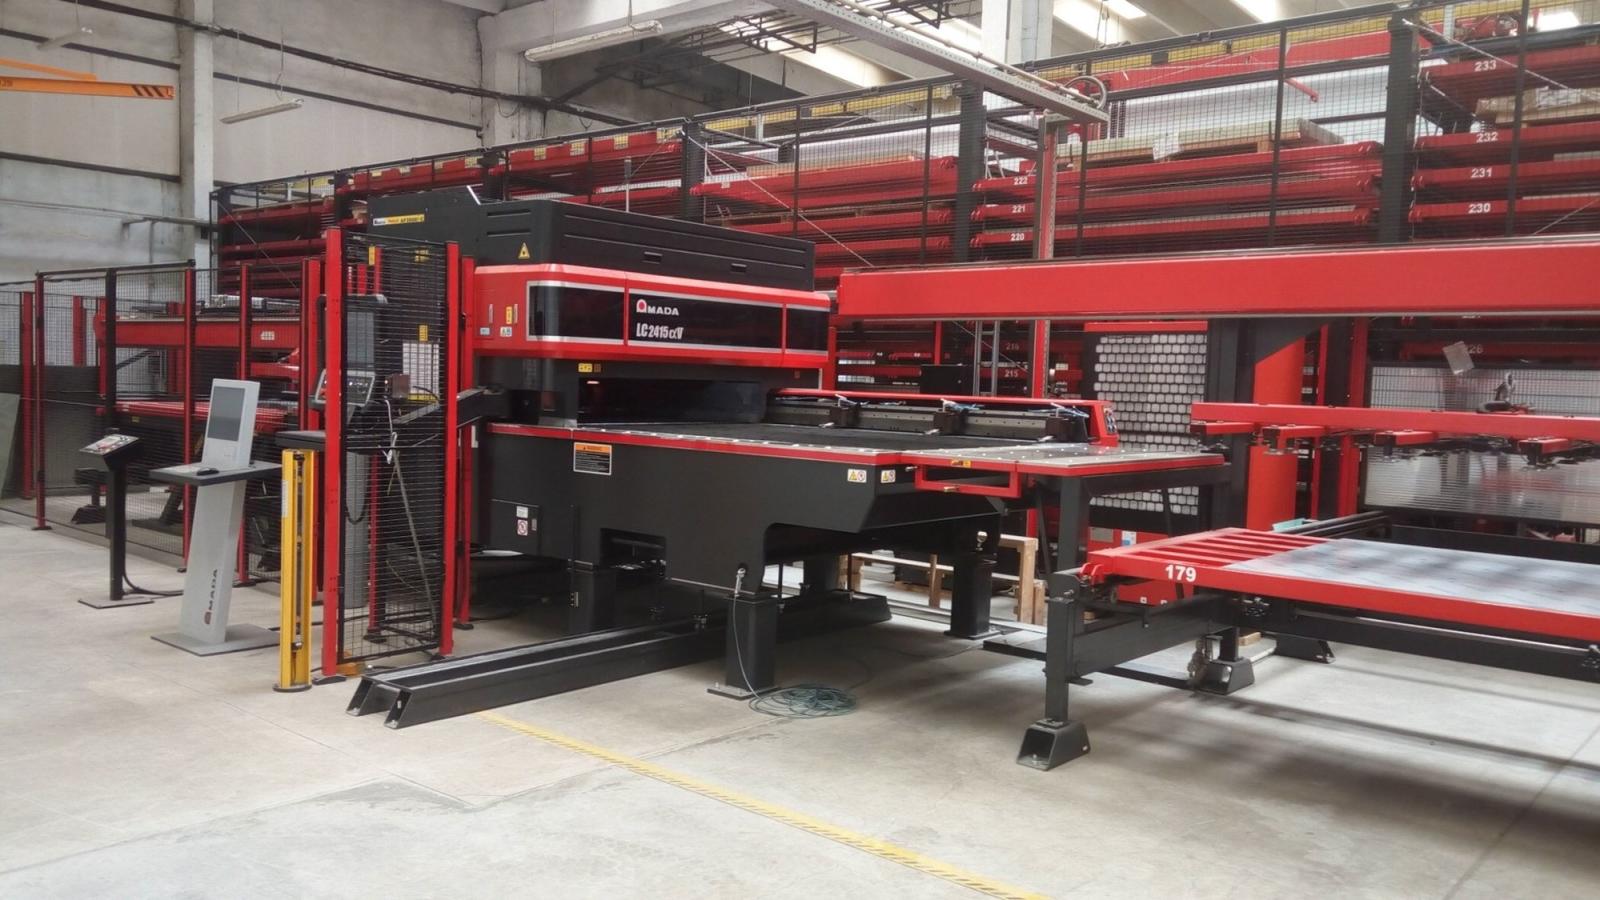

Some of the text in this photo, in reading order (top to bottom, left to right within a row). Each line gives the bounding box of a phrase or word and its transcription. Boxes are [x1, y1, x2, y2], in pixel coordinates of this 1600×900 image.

[1474, 59, 1497, 72] 233
[1476, 131, 1499, 143] 232
[1471, 167, 1493, 178] 231
[1013, 177, 1028, 185] 222
[1012, 205, 1026, 213] 221
[1468, 203, 1491, 214] 230
[1010, 233, 1025, 241] 220
[636, 299, 680, 316] AMADA
[1004, 369, 1019, 378] 215
[1165, 564, 1197, 583] 179
